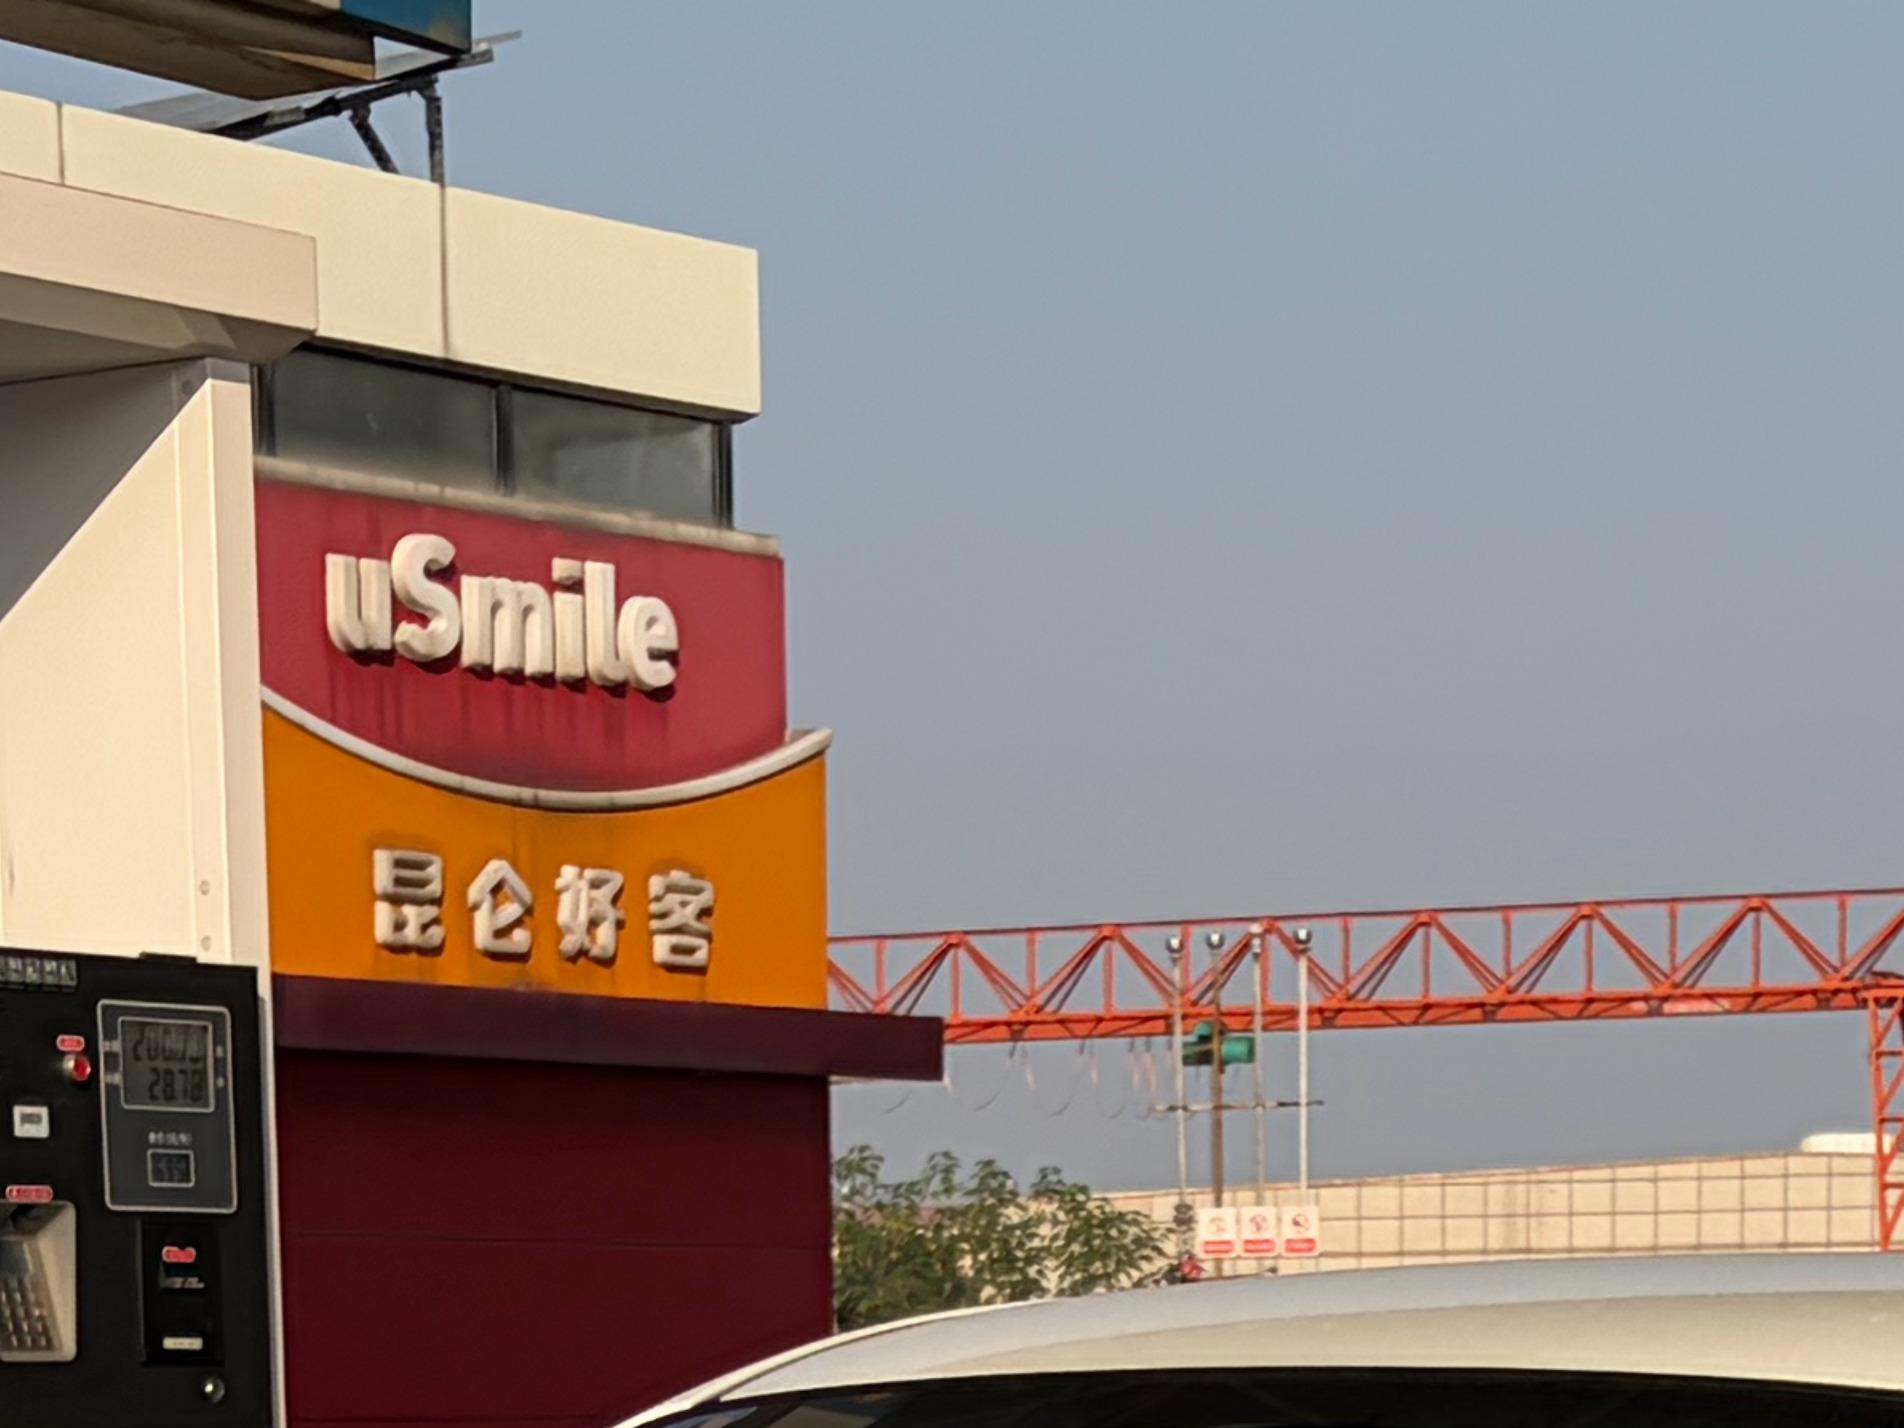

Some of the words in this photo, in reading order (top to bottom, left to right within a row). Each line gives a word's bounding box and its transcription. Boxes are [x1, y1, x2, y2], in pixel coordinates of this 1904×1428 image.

[324, 532, 680, 693] uSmile
[372, 847, 716, 968] 昆仑好客
